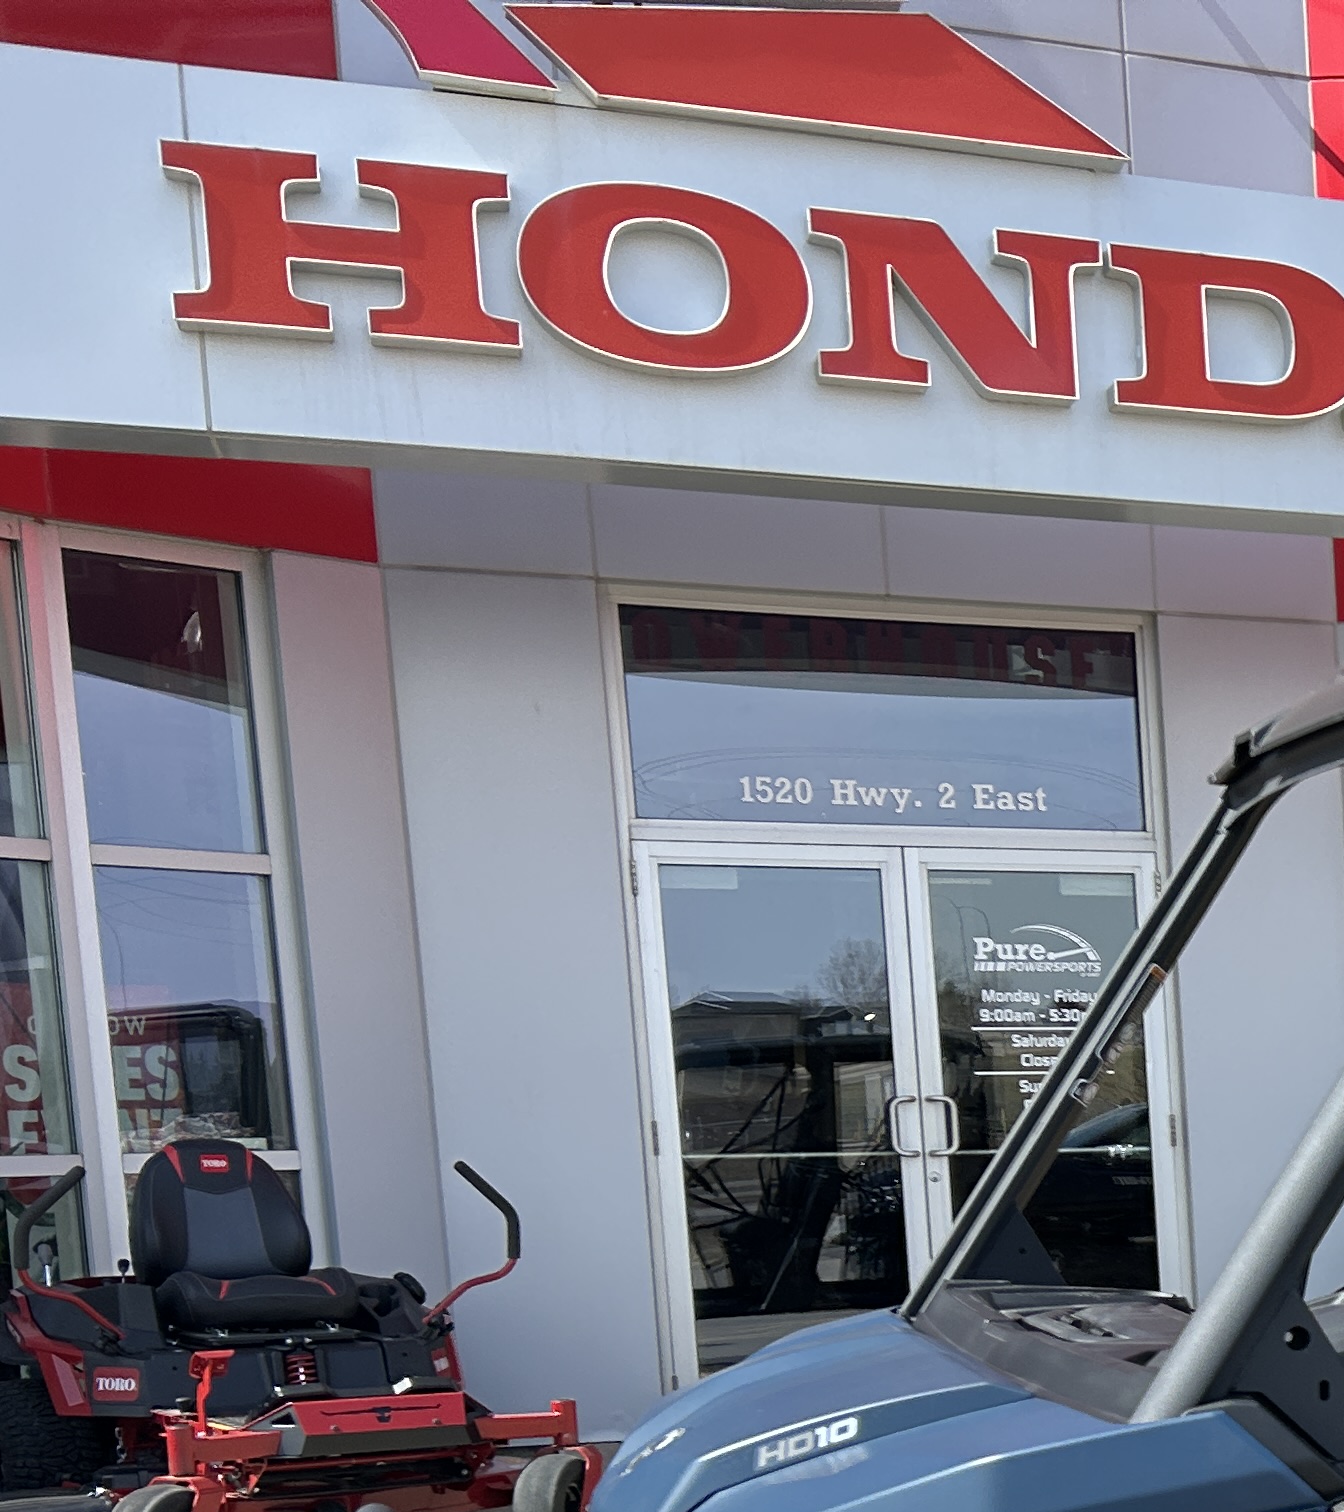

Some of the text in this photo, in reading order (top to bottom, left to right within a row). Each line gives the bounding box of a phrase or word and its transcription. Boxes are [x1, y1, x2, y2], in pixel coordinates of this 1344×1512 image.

[739, 776, 1047, 814] 1520 Hwy. 2 East
[972, 937, 1047, 961] Pure
[1006, 961, 1102, 973] POWERSPORTS
[981, 989, 1041, 1006] Monday
[979, 1008, 1036, 1022] 9:00am
[96, 1377, 137, 1391] TORO
[757, 1416, 859, 1468] HD10
